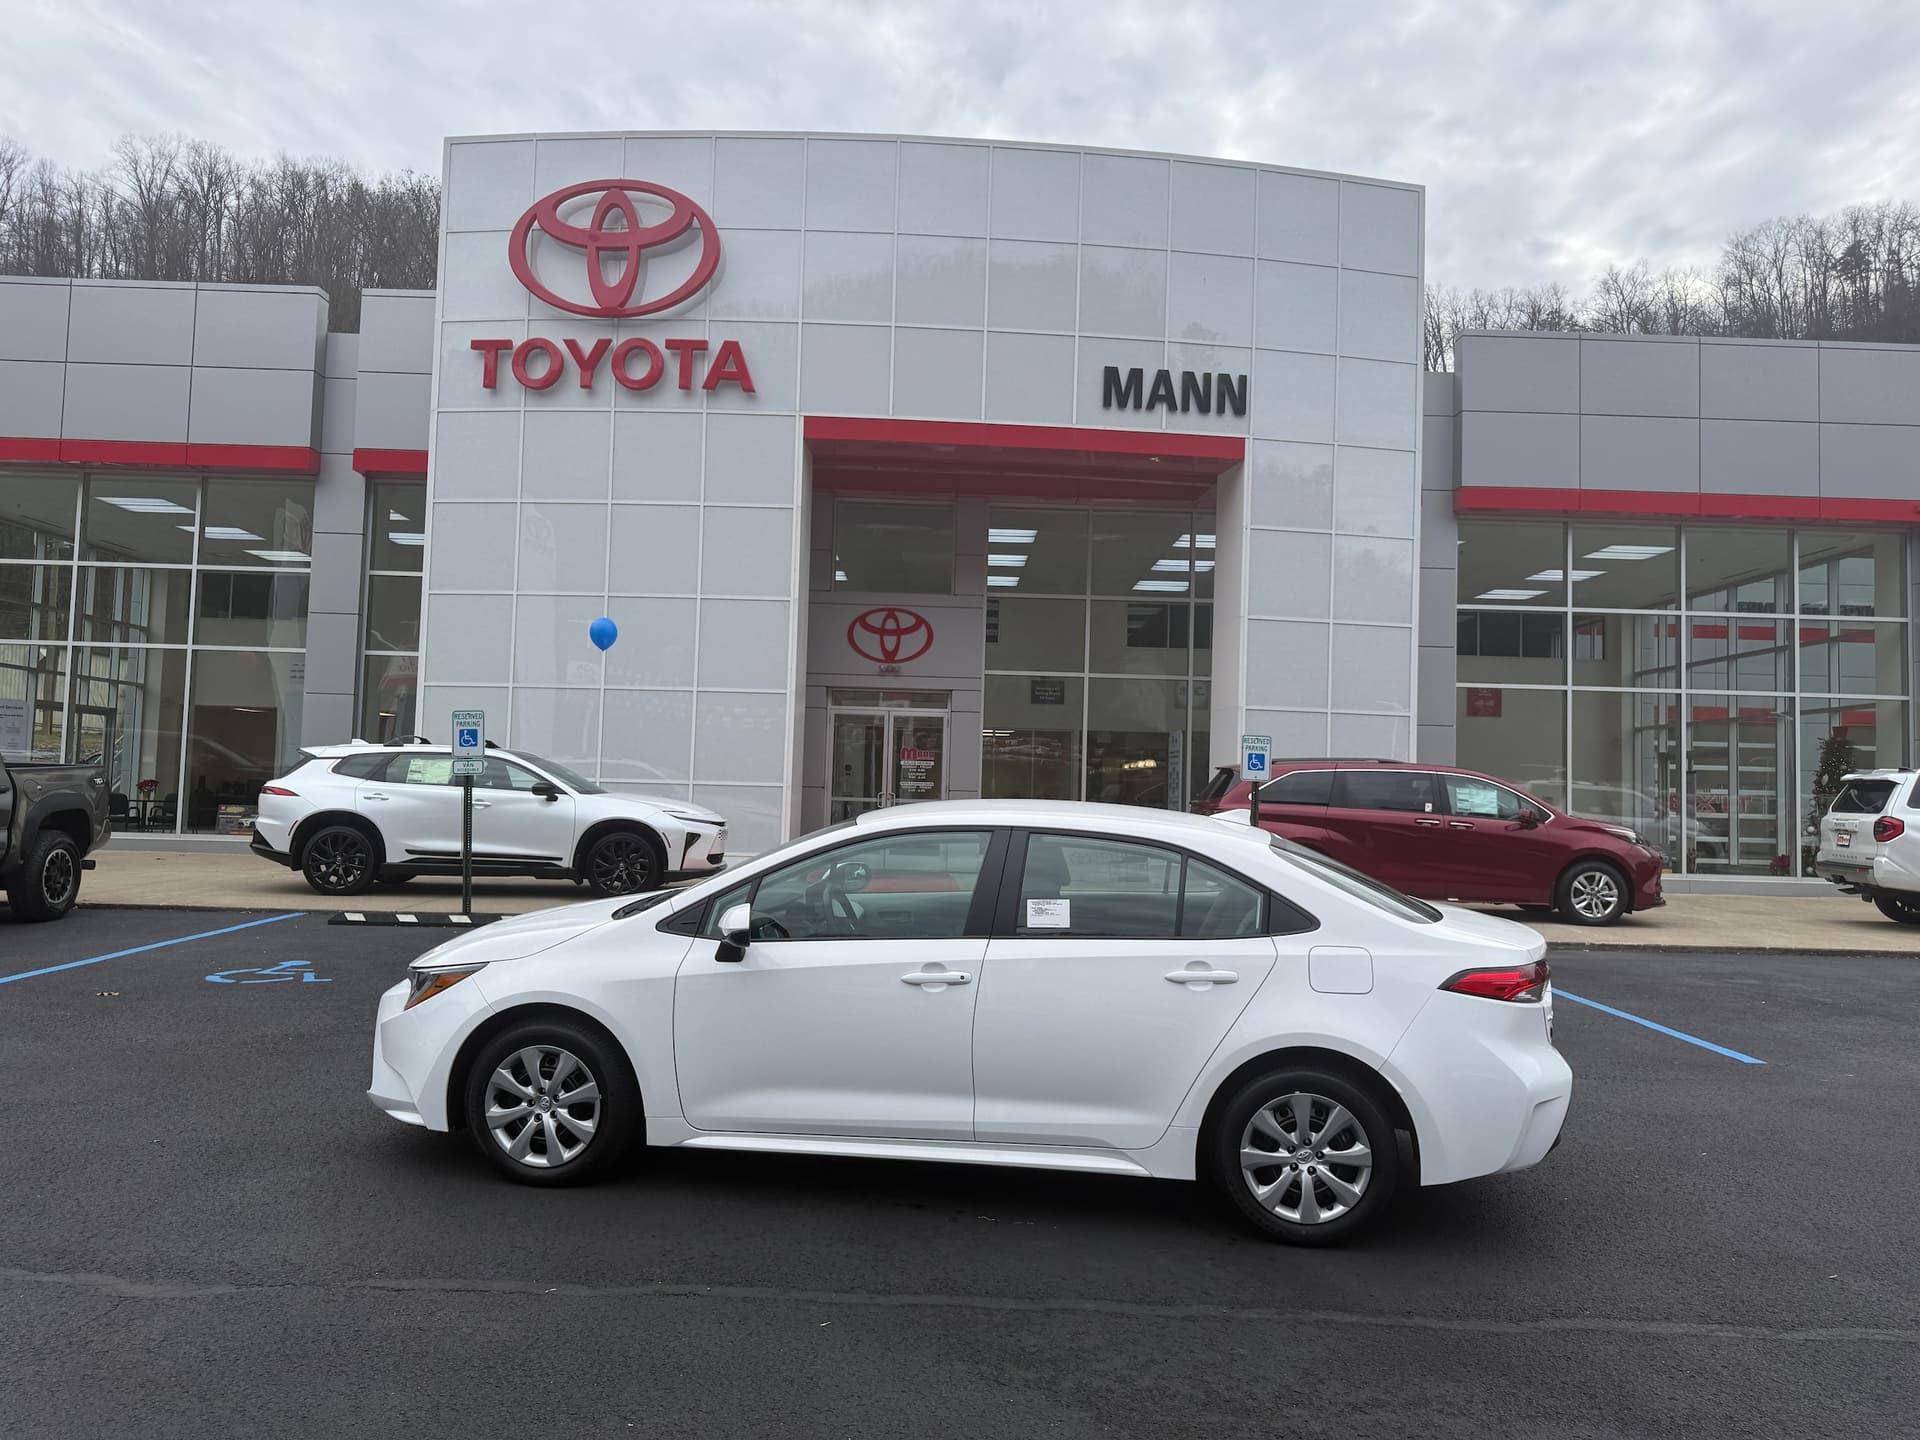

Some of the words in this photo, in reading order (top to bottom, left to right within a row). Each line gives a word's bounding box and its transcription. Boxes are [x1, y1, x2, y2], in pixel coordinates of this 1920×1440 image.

[470, 337, 756, 394] TOYOTA
[1102, 366, 1248, 416] MANN
[454, 712, 482, 720] RESERVED
[456, 720, 480, 728] PARKING
[1243, 737, 1270, 745] RESERVED
